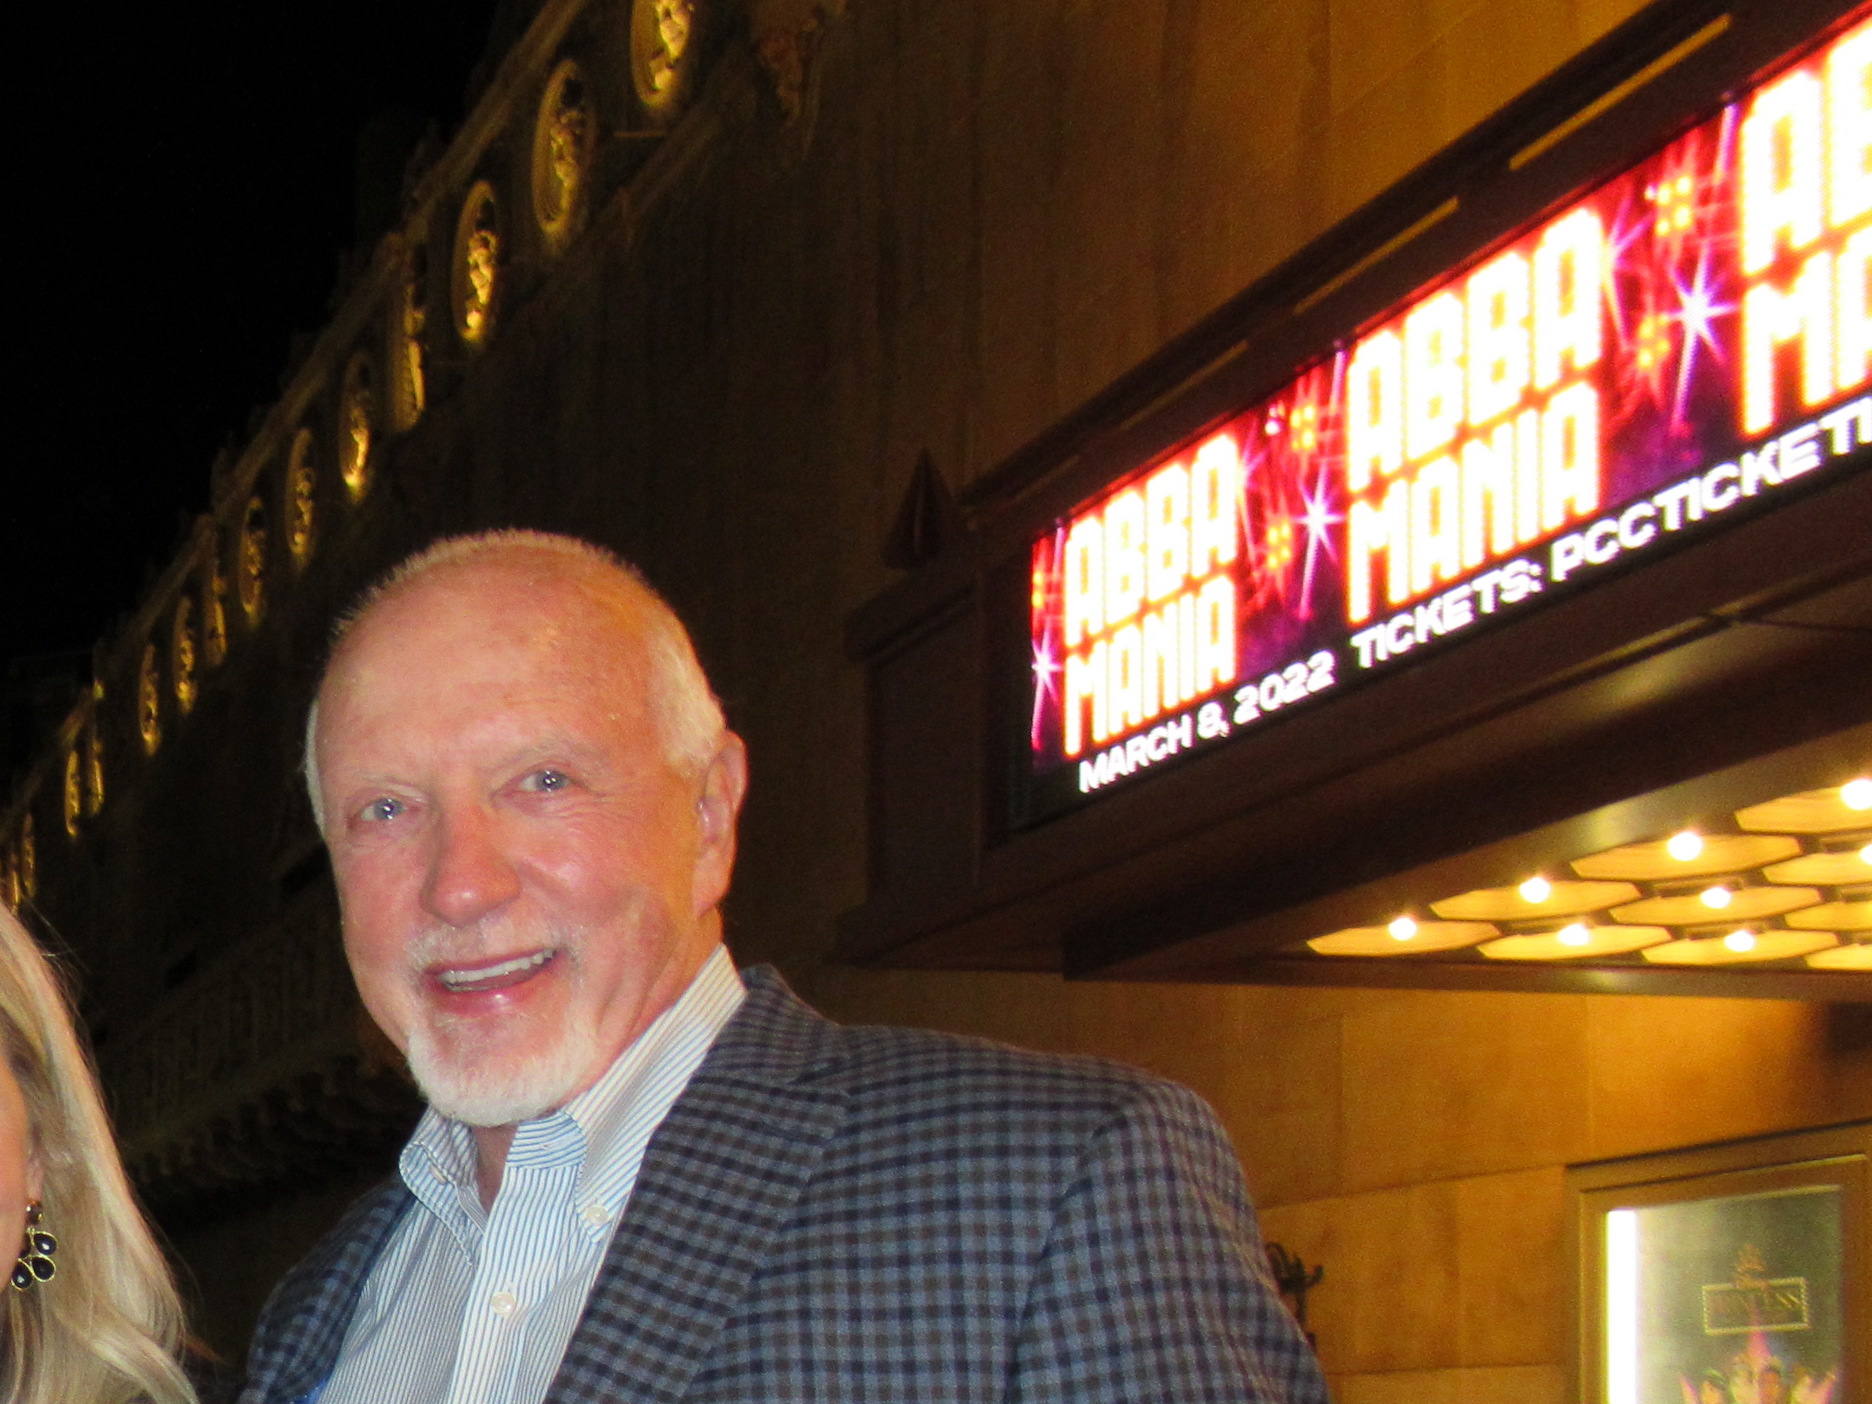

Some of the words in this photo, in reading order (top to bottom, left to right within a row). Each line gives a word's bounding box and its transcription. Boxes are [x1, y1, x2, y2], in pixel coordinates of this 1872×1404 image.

[1347, 208, 1602, 492] ABBA
[1065, 434, 1238, 646] ABBA
[1347, 381, 1600, 624] MANIA
[1065, 575, 1237, 755] MANIA
[1079, 714, 1192, 793] MARCH
[1197, 702, 1229, 737] 8,
[1233, 650, 1335, 724] 2022
[1349, 558, 1544, 668] TICKETS:
